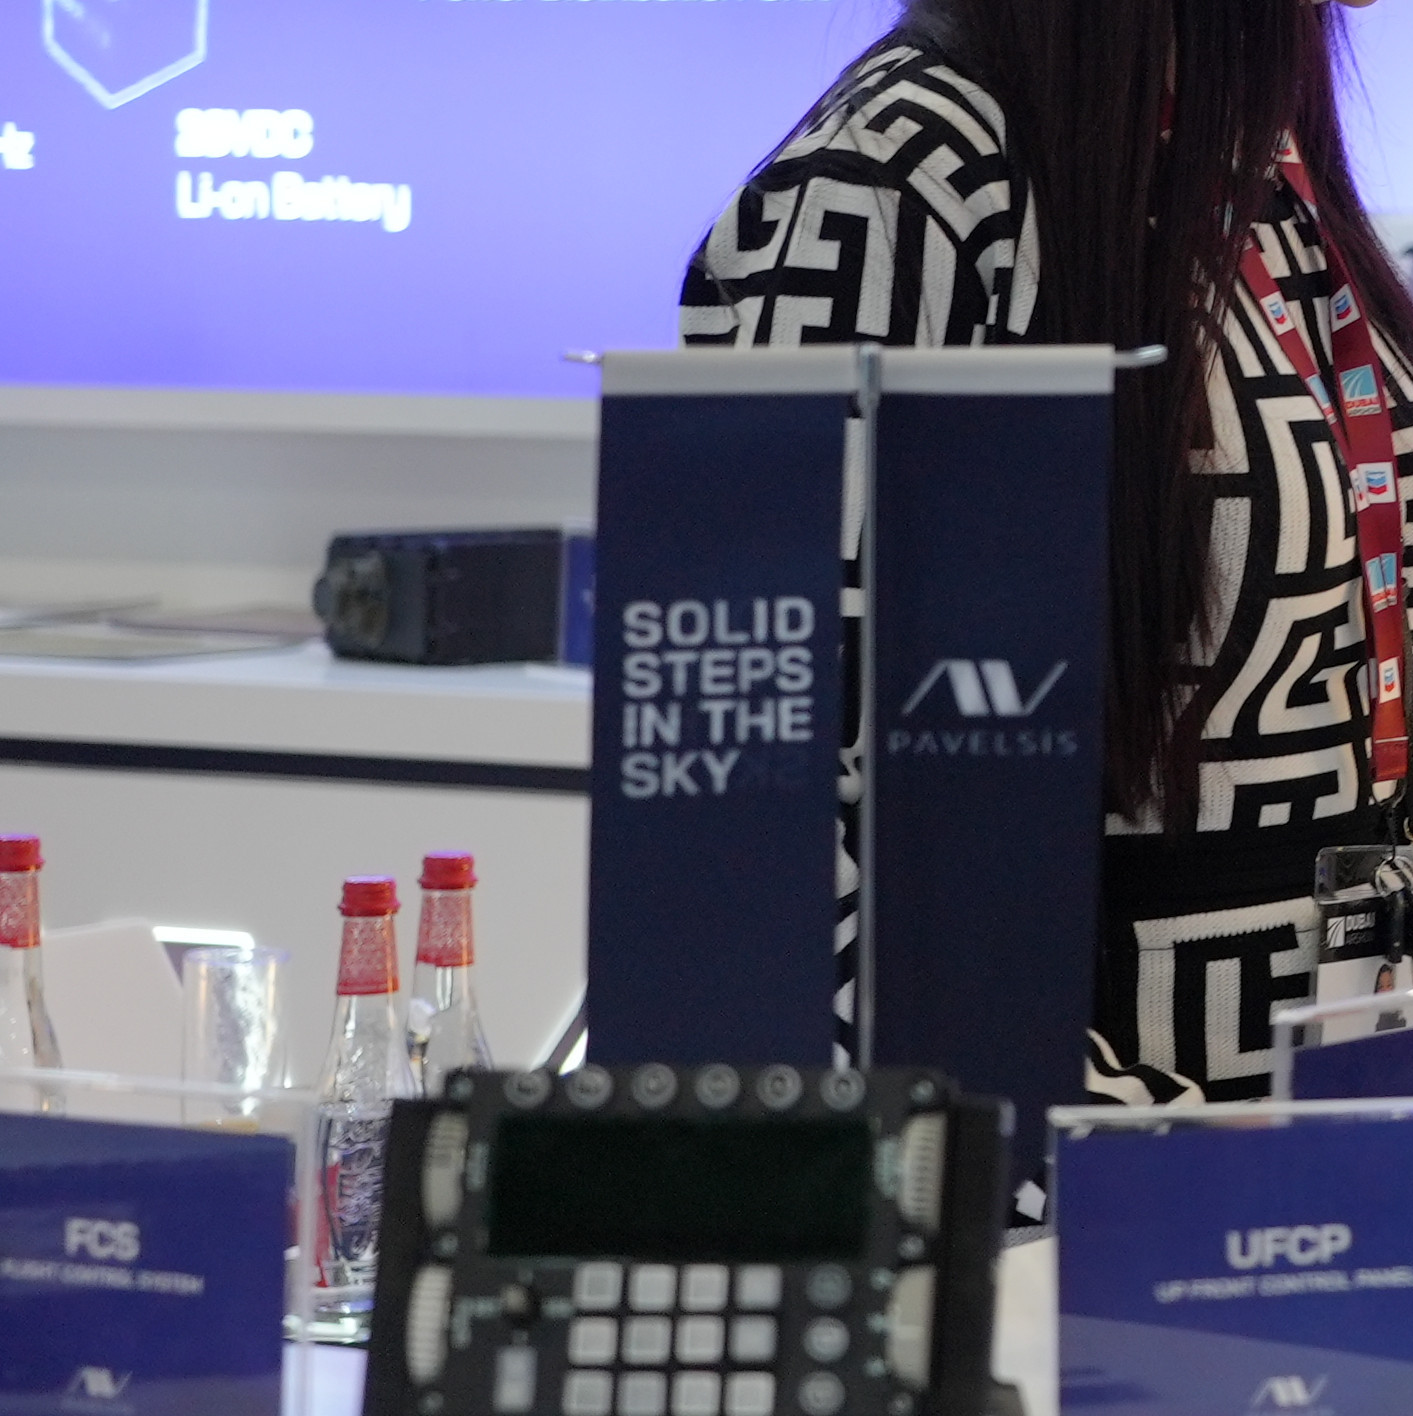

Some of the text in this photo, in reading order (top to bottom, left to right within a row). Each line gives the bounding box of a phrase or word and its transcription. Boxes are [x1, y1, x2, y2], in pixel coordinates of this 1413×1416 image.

[271, 171, 413, 233] Battery
[622, 596, 816, 649] SOLID
[622, 645, 815, 699] STEPS
[622, 696, 815, 749] IN THE
[620, 748, 741, 799] SKY
[64, 1217, 141, 1262] FCS
[1225, 1223, 1353, 1270] UFCP
